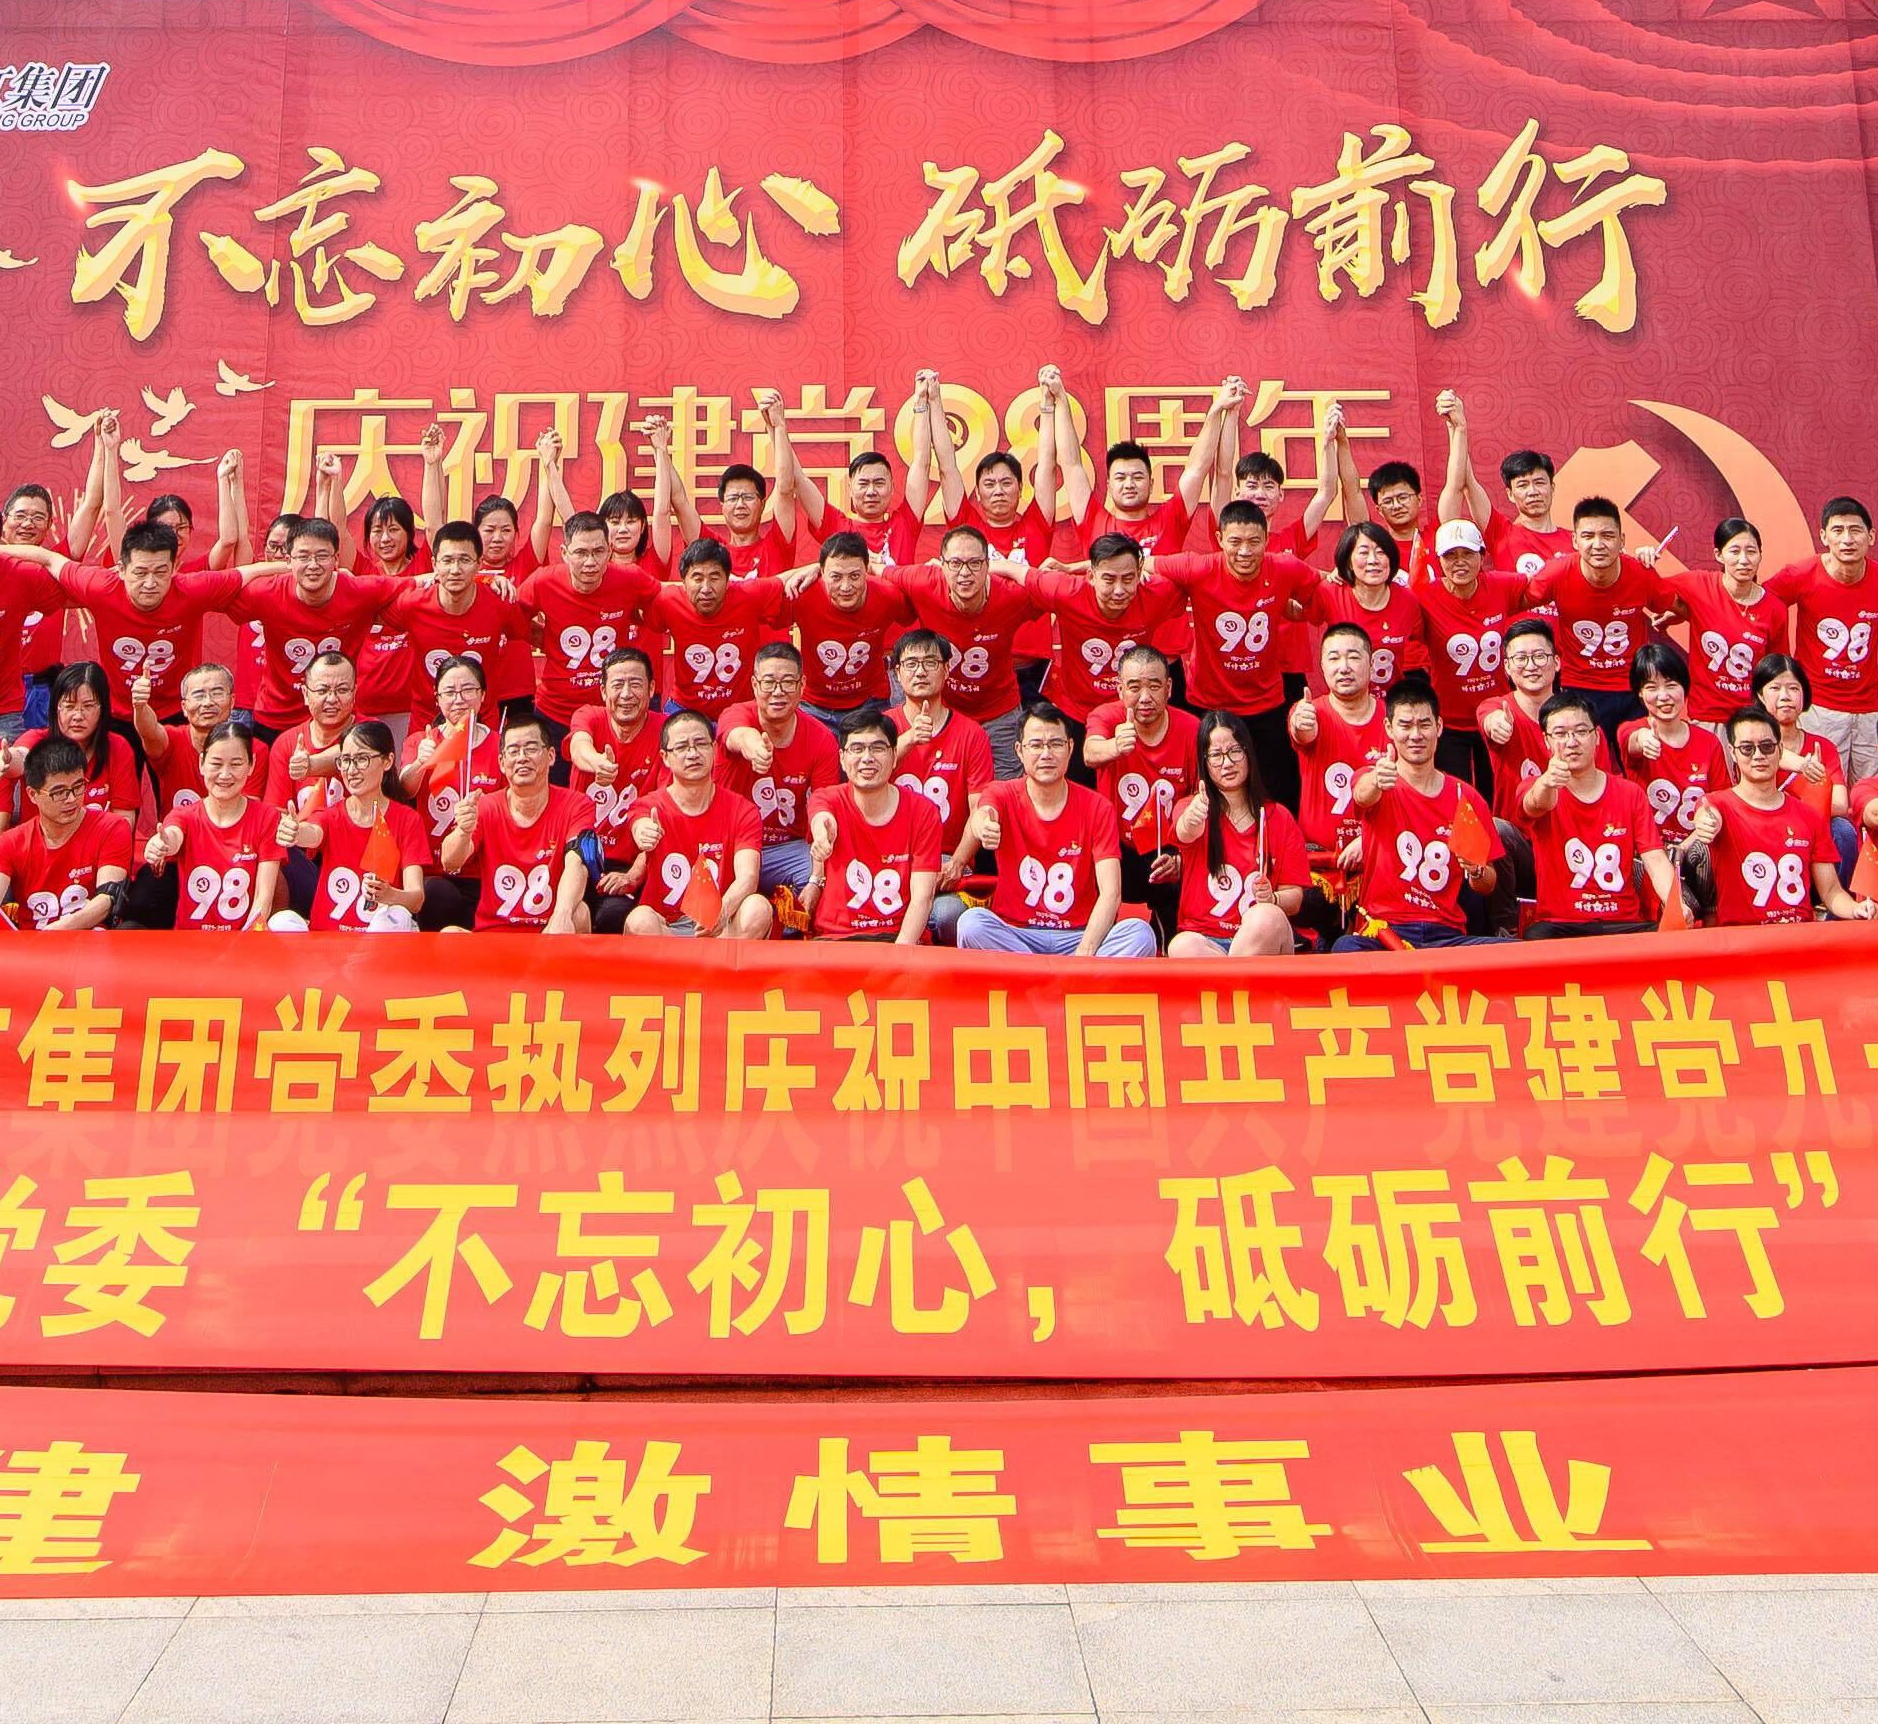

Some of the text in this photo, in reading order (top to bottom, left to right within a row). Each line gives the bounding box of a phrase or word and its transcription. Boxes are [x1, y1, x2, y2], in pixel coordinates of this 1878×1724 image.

[20, 112, 86, 128] GROUP
[67, 118, 1666, 342] 不忘初心 砥砺前行
[113, 637, 174, 672] 98
[560, 626, 617, 669] 98
[1215, 611, 1269, 653] 98
[1447, 630, 1502, 675] 98
[1572, 620, 1629, 656] 98
[1701, 631, 1754, 677] 98
[1817, 618, 1871, 662] 98
[685, 643, 741, 683] 98
[817, 640, 871, 676] 98
[752, 777, 795, 825] 98
[1647, 779, 1705, 830] 98
[1019, 855, 1074, 914] 98
[1396, 831, 1450, 891] 98
[1564, 837, 1624, 892] 98
[1742, 852, 1805, 907] 98
[187, 865, 250, 920] 98
[494, 864, 553, 918] 98
[846, 859, 903, 914] 98
[468, 1428, 1652, 1570] 激情事业
